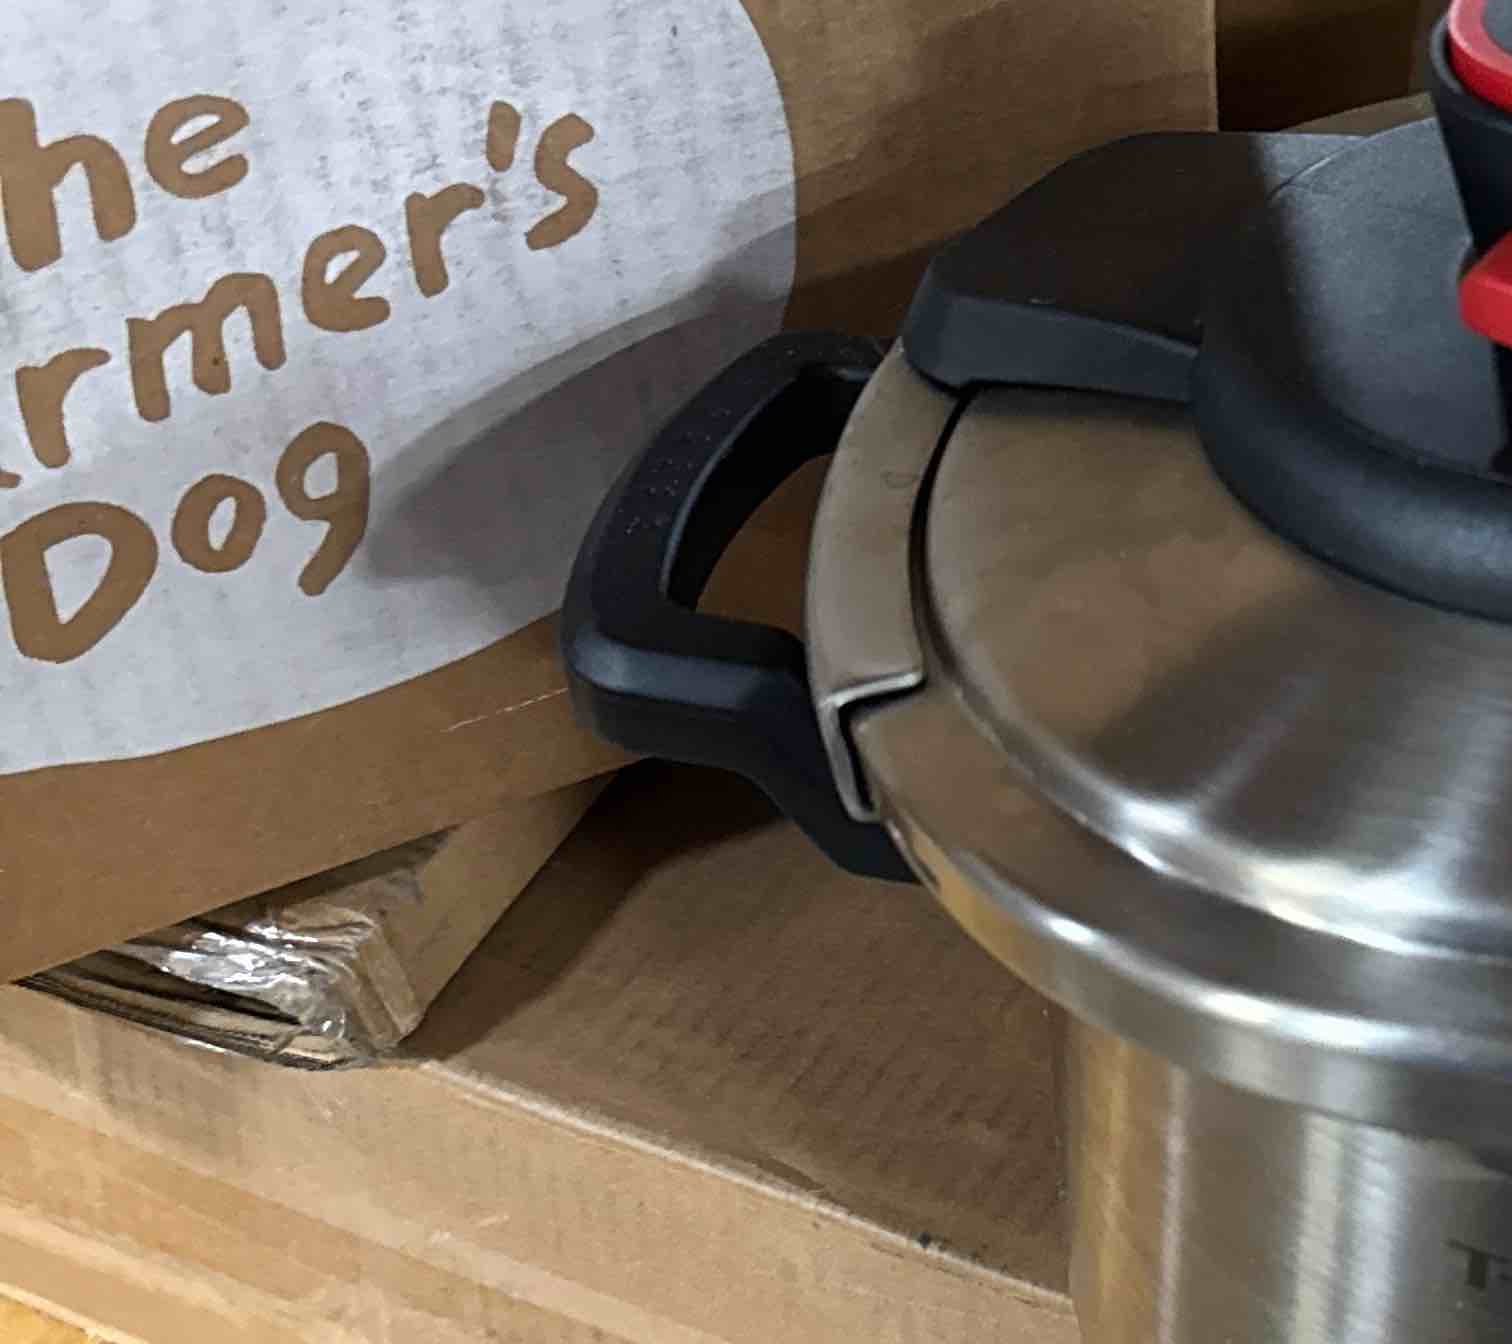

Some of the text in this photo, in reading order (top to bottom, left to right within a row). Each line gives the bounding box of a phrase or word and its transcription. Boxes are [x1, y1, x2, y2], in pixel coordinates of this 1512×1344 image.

[0, 93, 250, 273] he
[0, 111, 599, 489] rmer's
[0, 421, 371, 663] Dog
